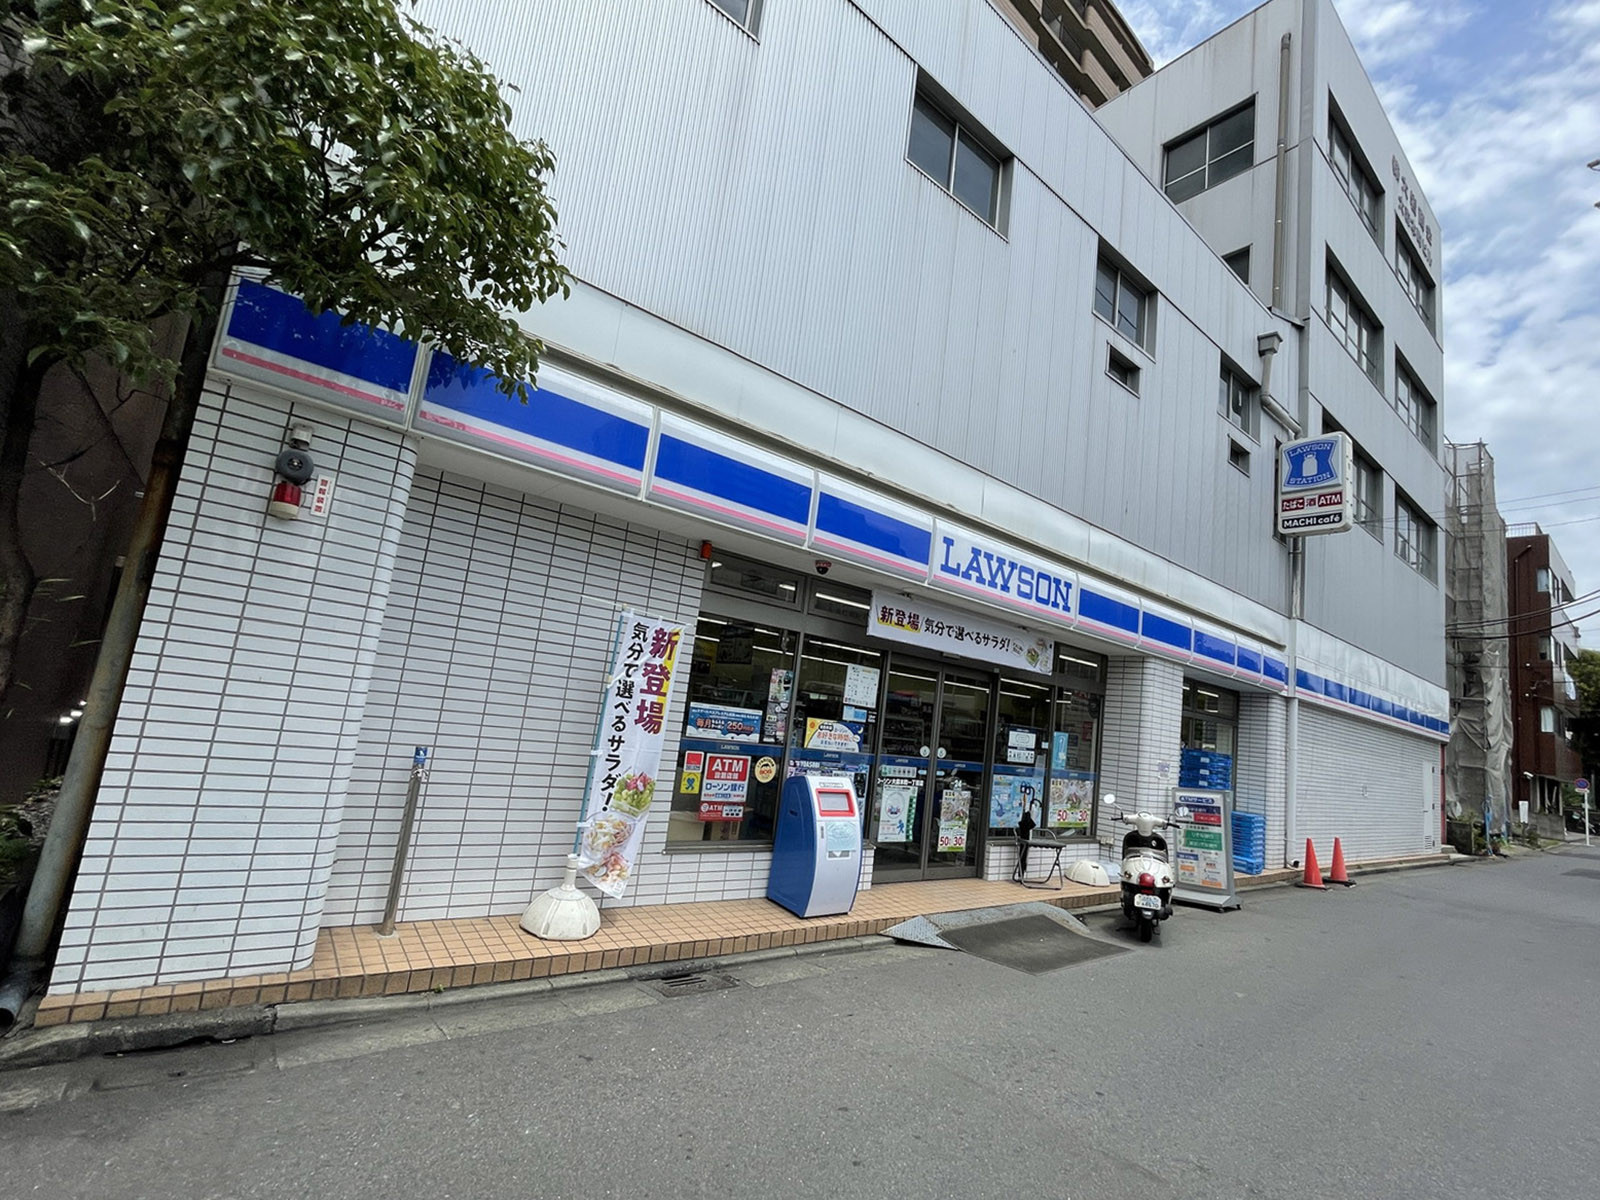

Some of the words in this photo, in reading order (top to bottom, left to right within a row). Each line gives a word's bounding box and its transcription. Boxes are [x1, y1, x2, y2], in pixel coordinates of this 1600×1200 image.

[1289, 443, 1332, 457] LAWSON
[1289, 472, 1331, 484] STATION
[1319, 494, 1341, 505] ATM
[1284, 517, 1317, 528] MACHI
[940, 536, 1073, 613] LAWSON
[879, 605, 921, 631] 新登場
[634, 627, 681, 735] 新登場
[600, 622, 650, 812] 気分で選べるサラダ!
[712, 759, 743, 772] ATM
[705, 782, 745, 792] ローソン銀行
